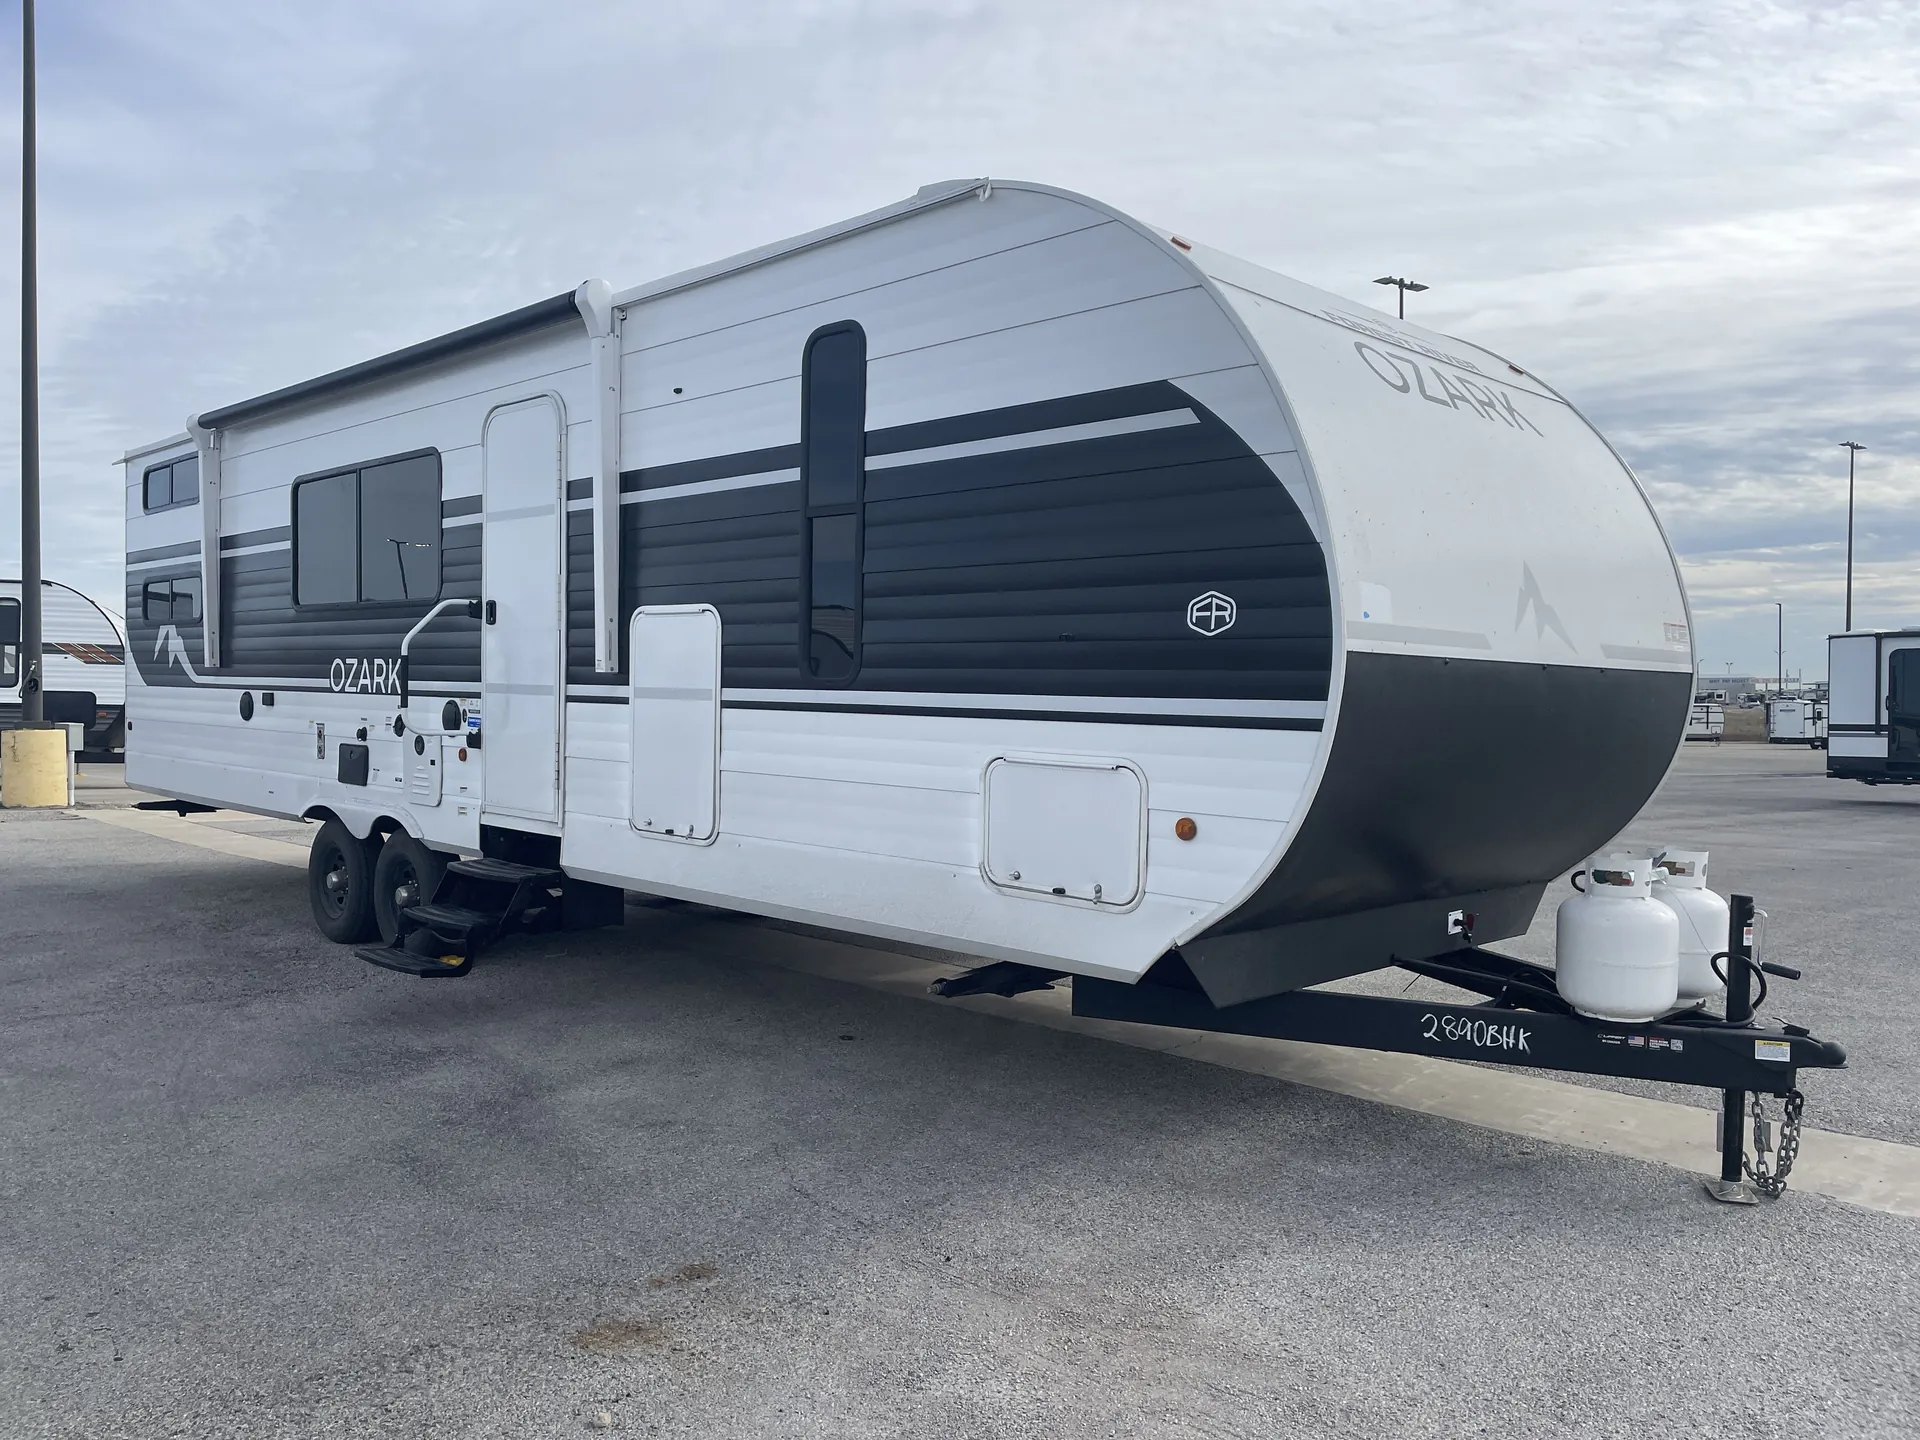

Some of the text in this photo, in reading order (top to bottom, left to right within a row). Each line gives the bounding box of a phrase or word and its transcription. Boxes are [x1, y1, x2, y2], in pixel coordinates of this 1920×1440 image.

[1353, 341, 1544, 438] OZARK
[330, 658, 401, 694] OZARK
[1420, 1013, 1532, 1055] 2890BHK
